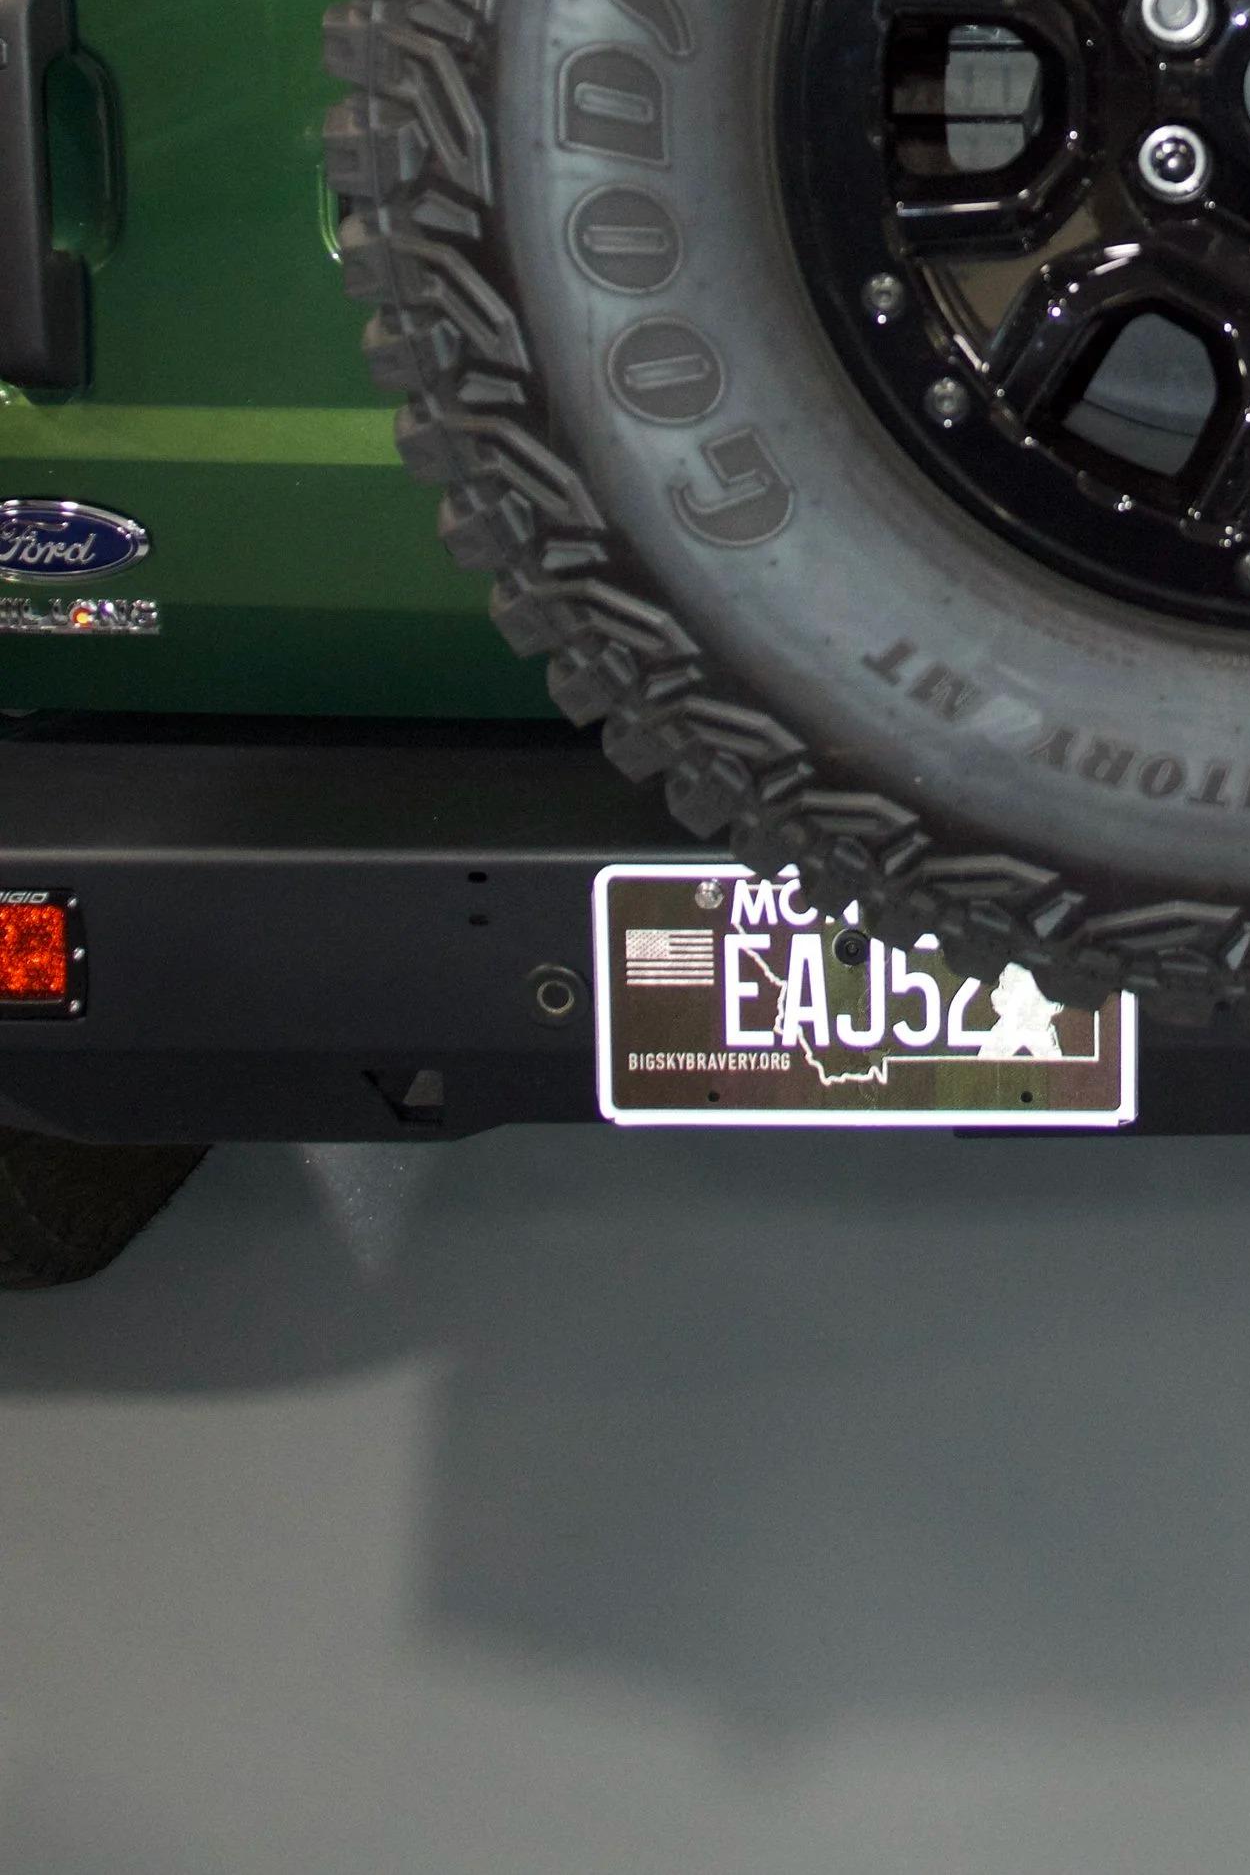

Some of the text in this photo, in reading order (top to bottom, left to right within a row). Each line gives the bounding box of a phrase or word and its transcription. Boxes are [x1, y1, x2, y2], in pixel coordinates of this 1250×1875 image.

[0, 518, 98, 565] Ford
[860, 637, 984, 727] MT
[628, 1052, 791, 1071] BIGSKYBRAVERY.ORG
